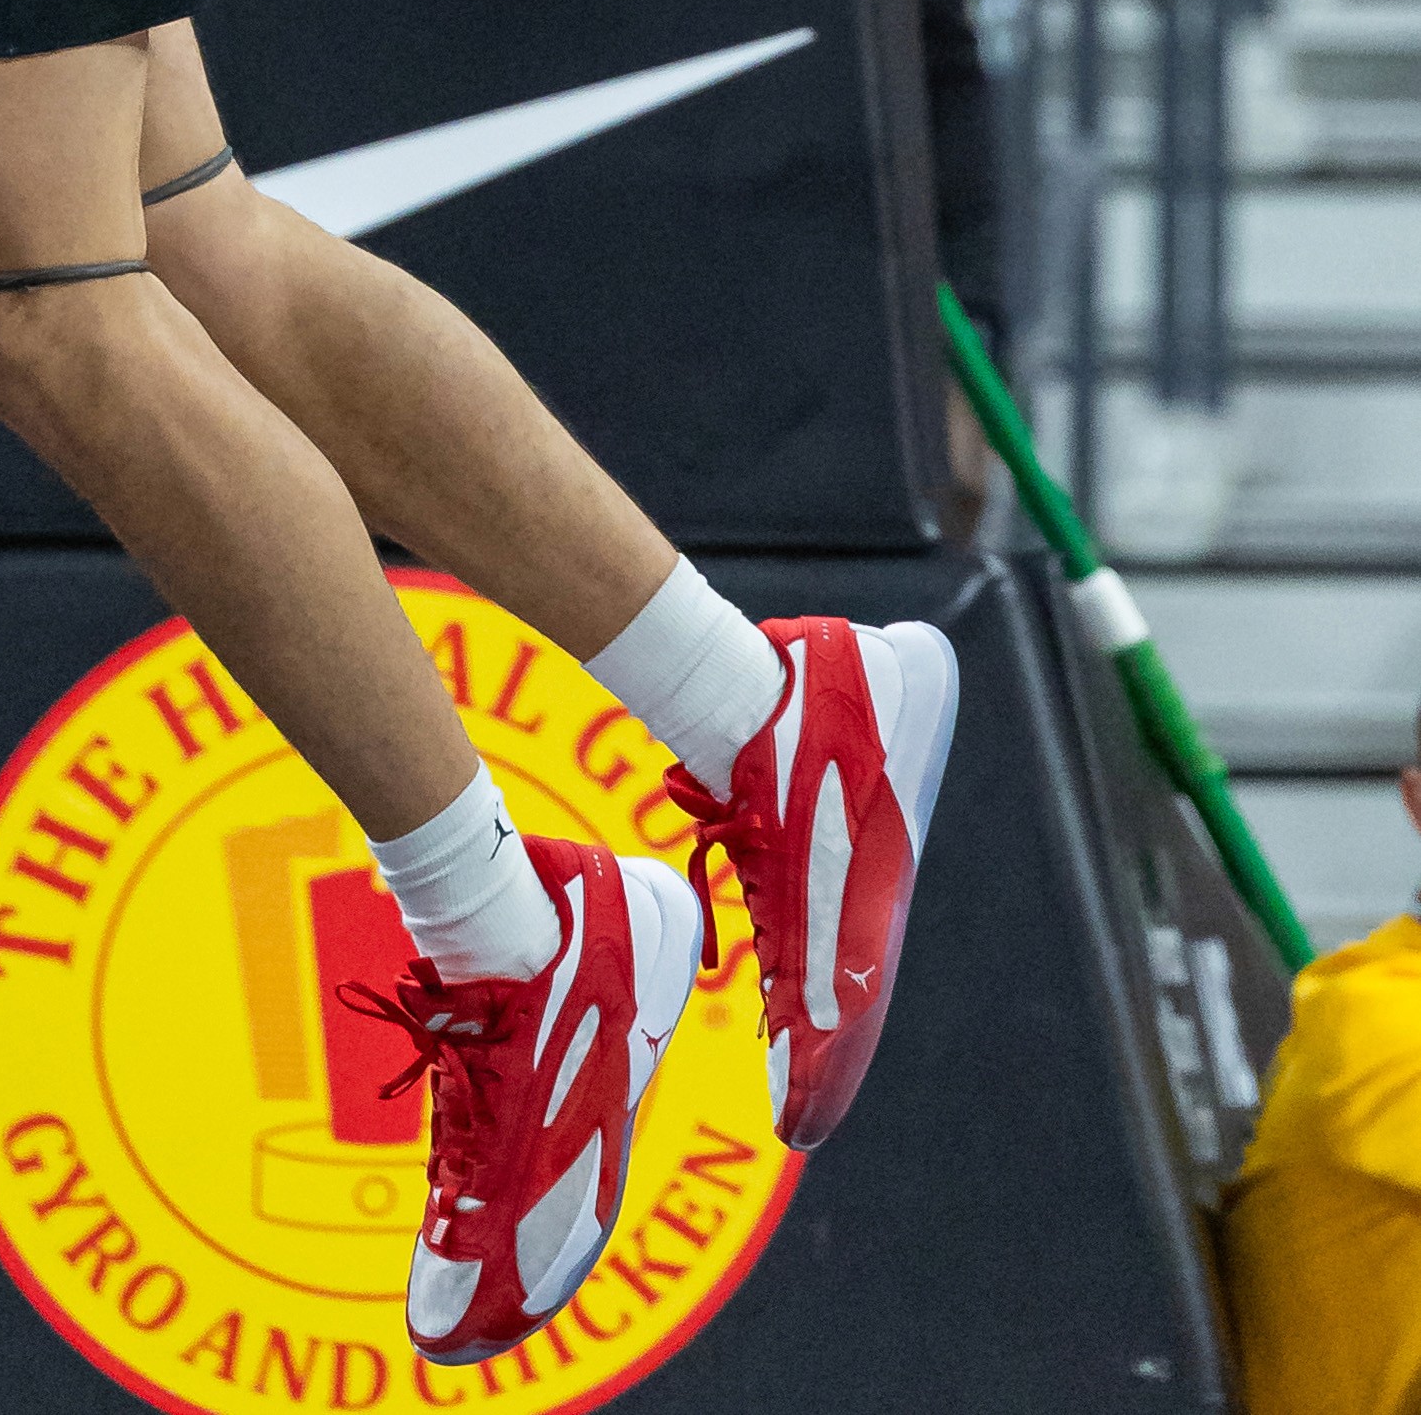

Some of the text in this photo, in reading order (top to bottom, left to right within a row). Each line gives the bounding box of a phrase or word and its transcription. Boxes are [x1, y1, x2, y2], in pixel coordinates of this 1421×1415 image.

[143, 619, 545, 761] HAL
[2, 1113, 188, 1334] GYRO
[180, 1310, 391, 1411] AND
